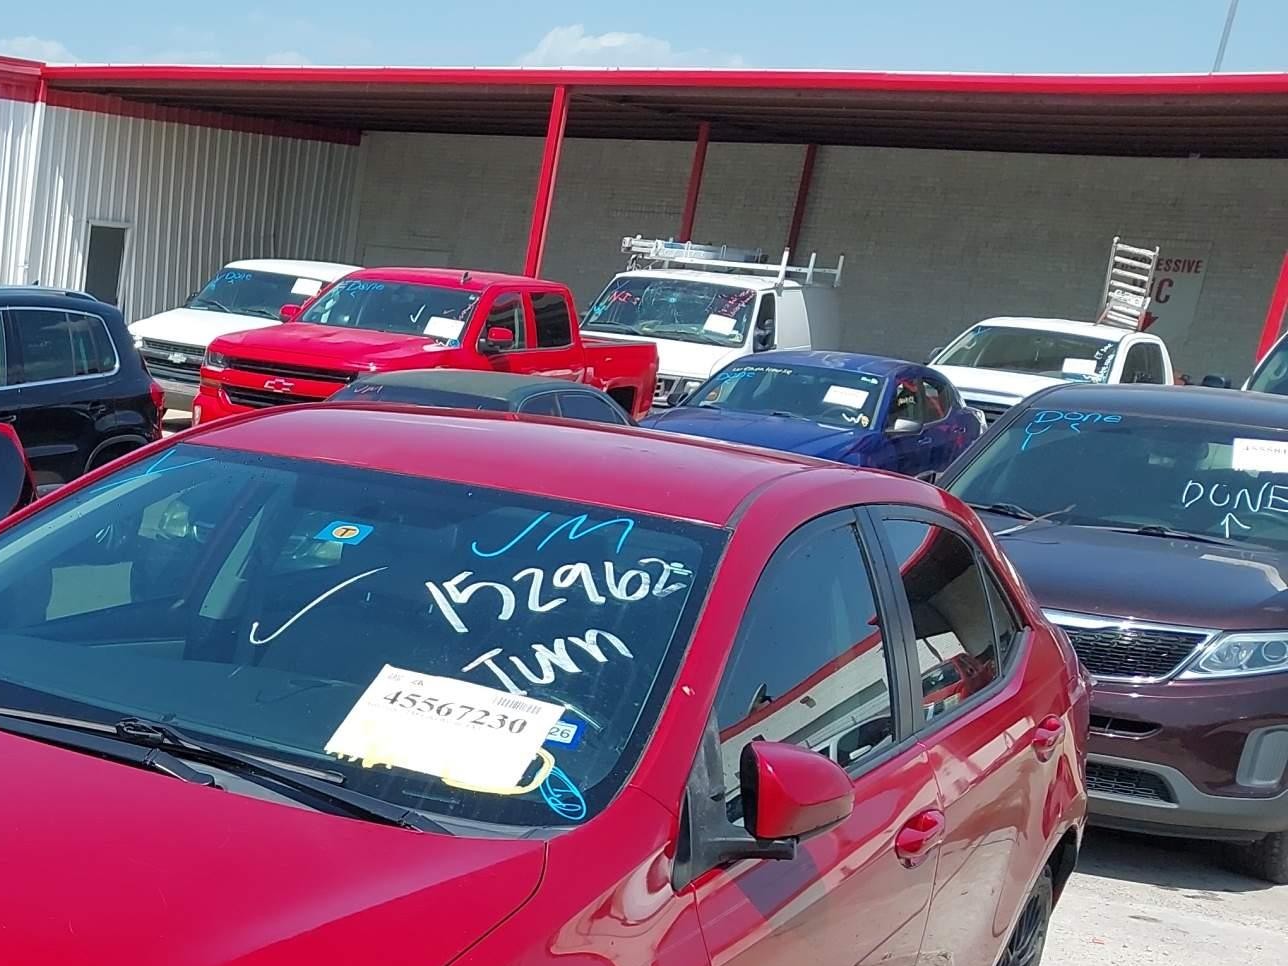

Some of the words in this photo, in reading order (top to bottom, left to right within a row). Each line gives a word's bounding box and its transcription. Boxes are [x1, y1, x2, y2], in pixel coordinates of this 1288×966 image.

[1034, 411, 1123, 424] Done
[1182, 479, 1288, 513] DONE
[472, 511, 635, 558] JM
[462, 629, 634, 696] Turn
[383, 690, 528, 735] 45567230
